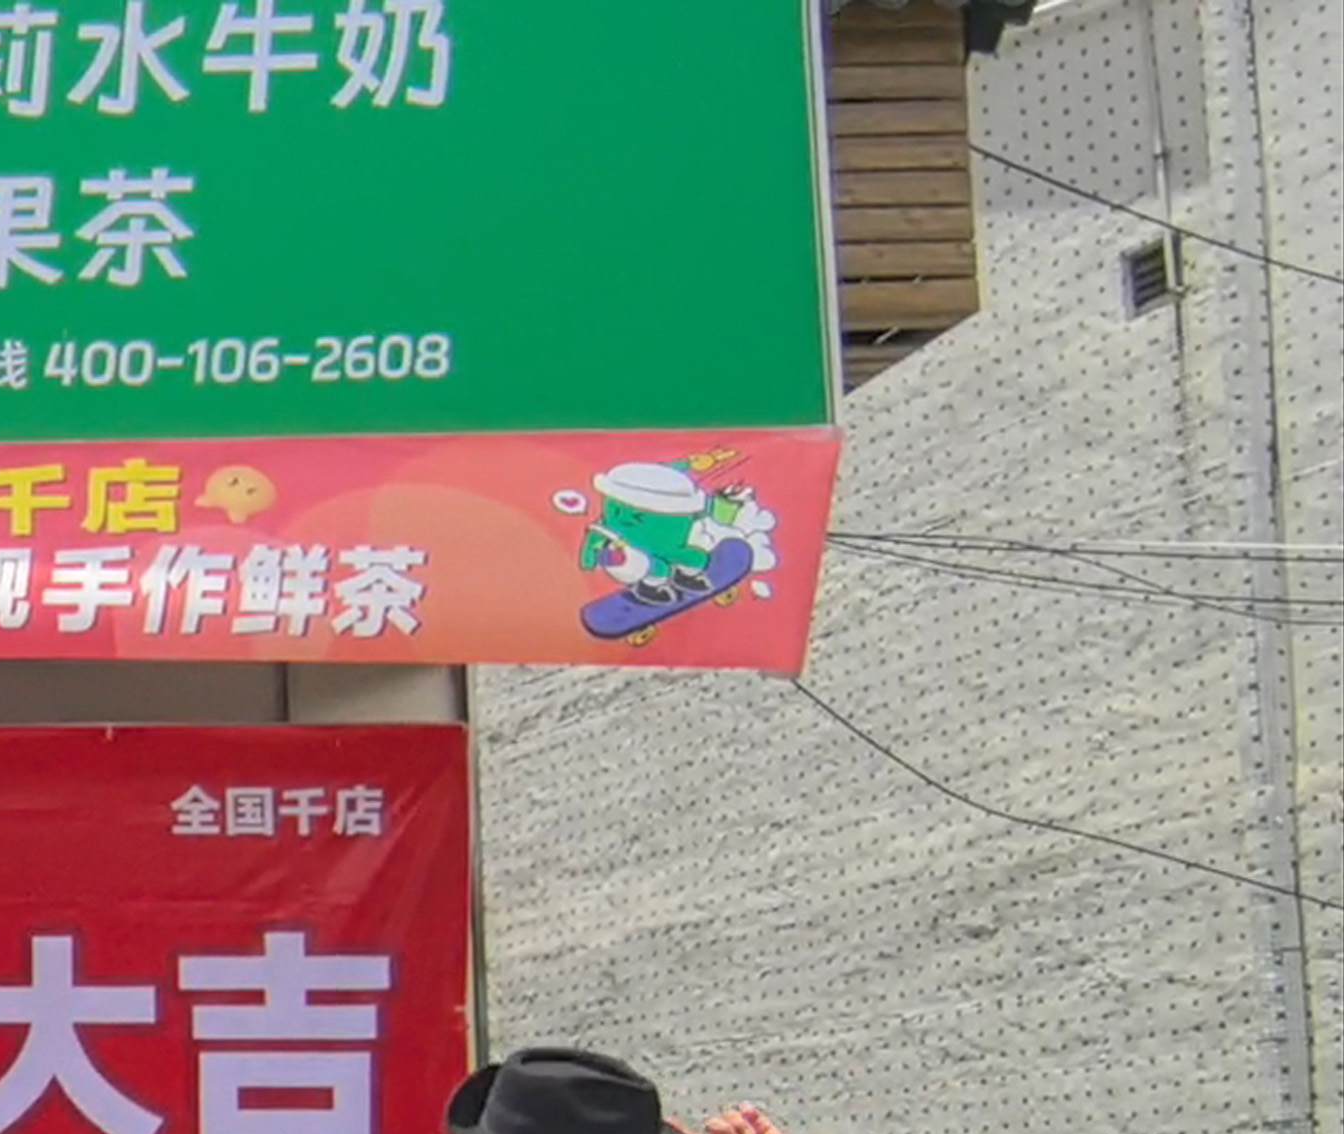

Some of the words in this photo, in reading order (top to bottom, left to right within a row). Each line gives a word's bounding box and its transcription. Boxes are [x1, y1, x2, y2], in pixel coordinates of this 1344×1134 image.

[44, 335, 450, 387] 400-106-2608
[170, 784, 383, 839] 全国千店
